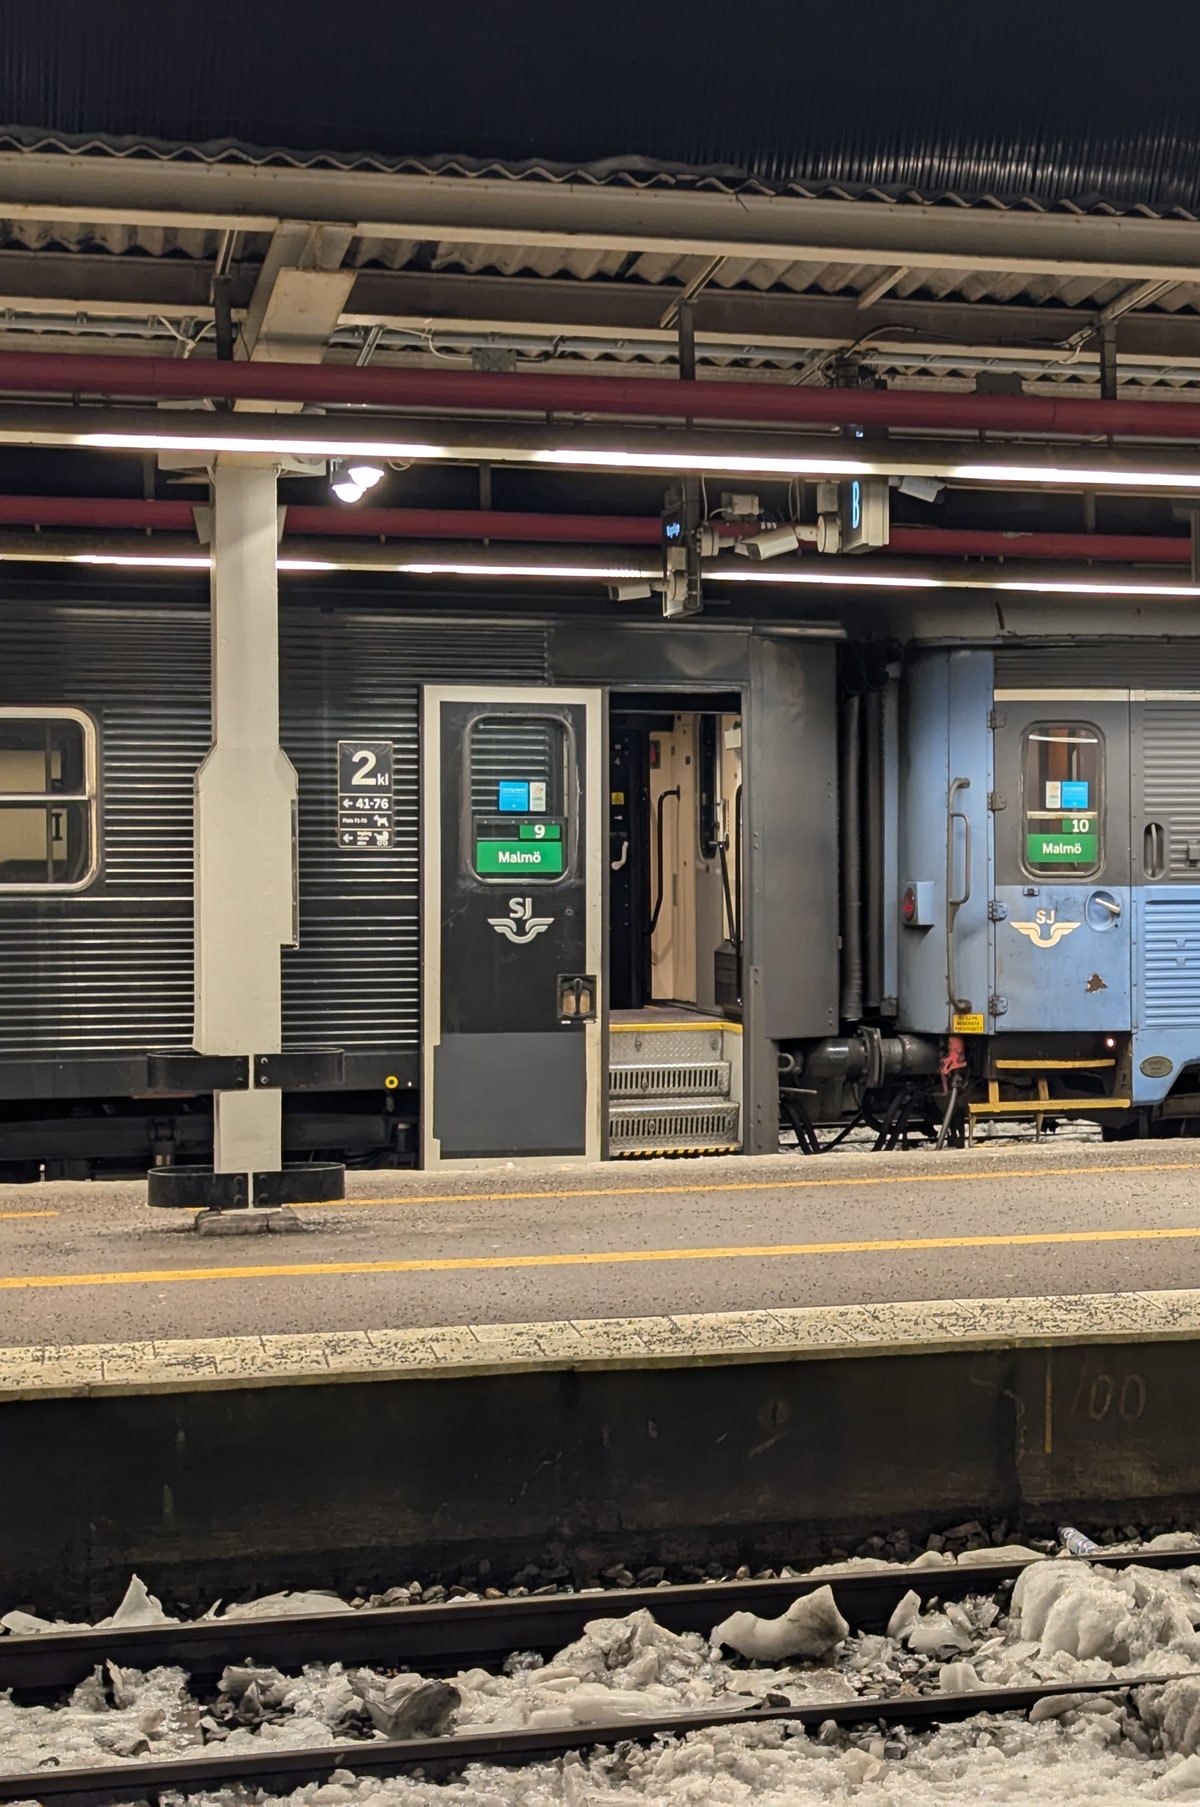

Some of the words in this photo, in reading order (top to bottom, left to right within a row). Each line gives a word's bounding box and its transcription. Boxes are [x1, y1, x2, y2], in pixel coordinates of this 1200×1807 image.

[852, 481, 859, 528] B
[351, 750, 377, 786] 2
[355, 798, 389, 809] 41-76
[534, 825, 546, 839] 9
[1072, 820, 1089, 833] 10
[1042, 843, 1082, 855] Malmö
[498, 851, 542, 864] Malmö
[509, 897, 533, 920] SJ
[1035, 910, 1055, 925] SJ
